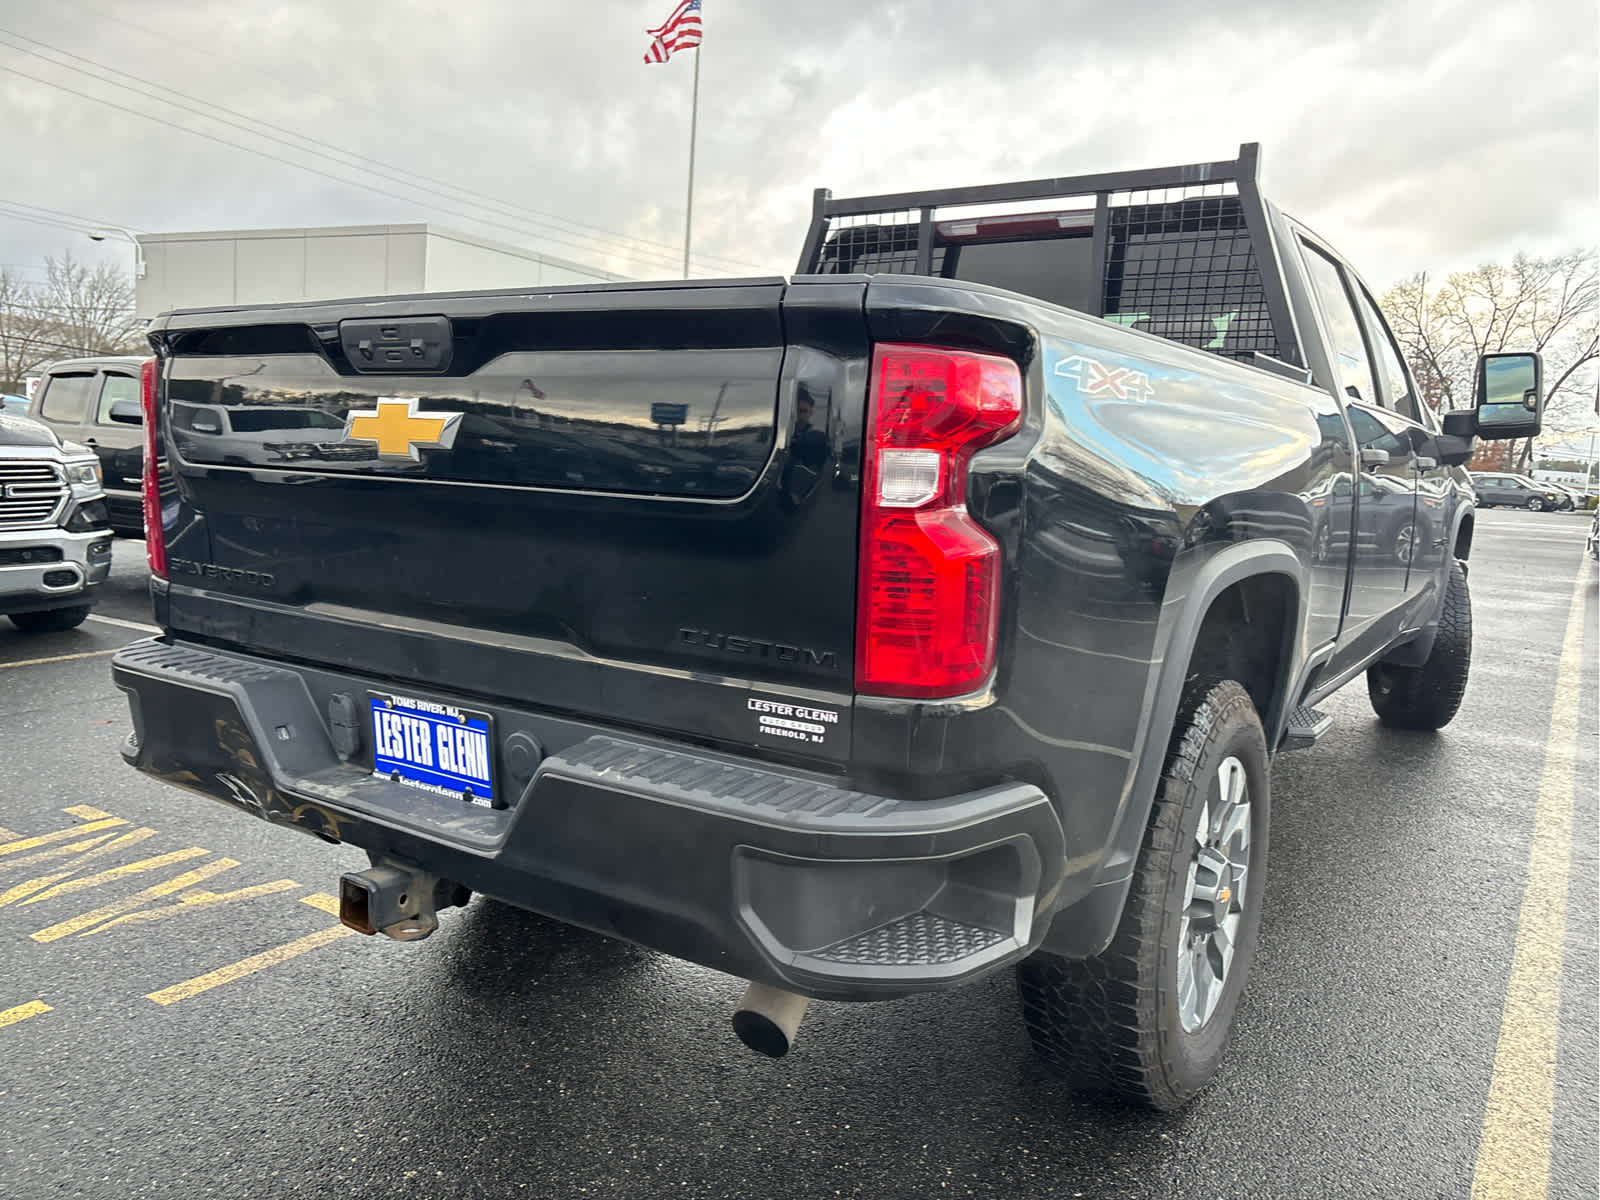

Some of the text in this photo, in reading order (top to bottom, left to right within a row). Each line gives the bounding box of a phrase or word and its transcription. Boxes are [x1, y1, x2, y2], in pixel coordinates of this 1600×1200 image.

[679, 627, 839, 671] CUSTOM
[391, 695, 417, 710] TOMS
[446, 705, 459, 718] NJ
[747, 698, 838, 724] LESTER GLENN
[374, 711, 490, 782] LESTER GLENN
